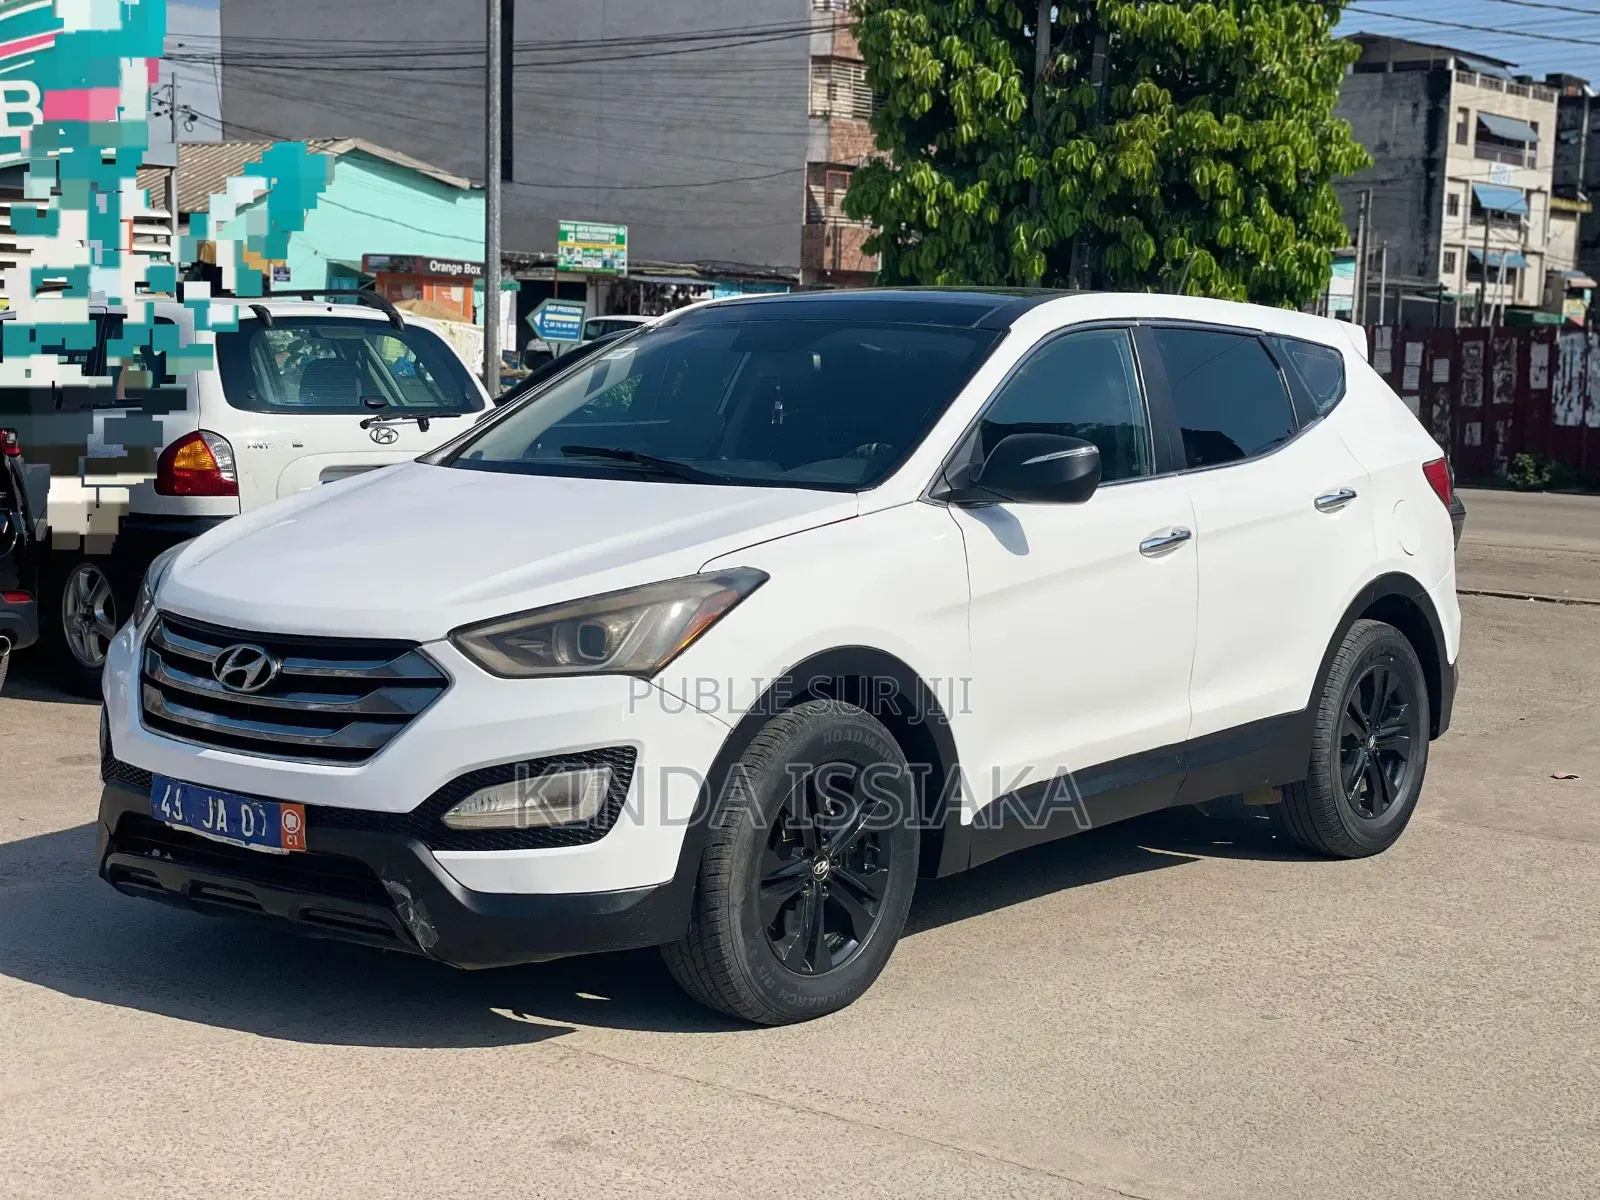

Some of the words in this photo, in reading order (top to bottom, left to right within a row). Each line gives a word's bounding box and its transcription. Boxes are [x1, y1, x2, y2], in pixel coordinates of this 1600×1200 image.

[429, 260, 463, 276] Orange
[464, 263, 481, 276] Box
[202, 796, 229, 833] JA
